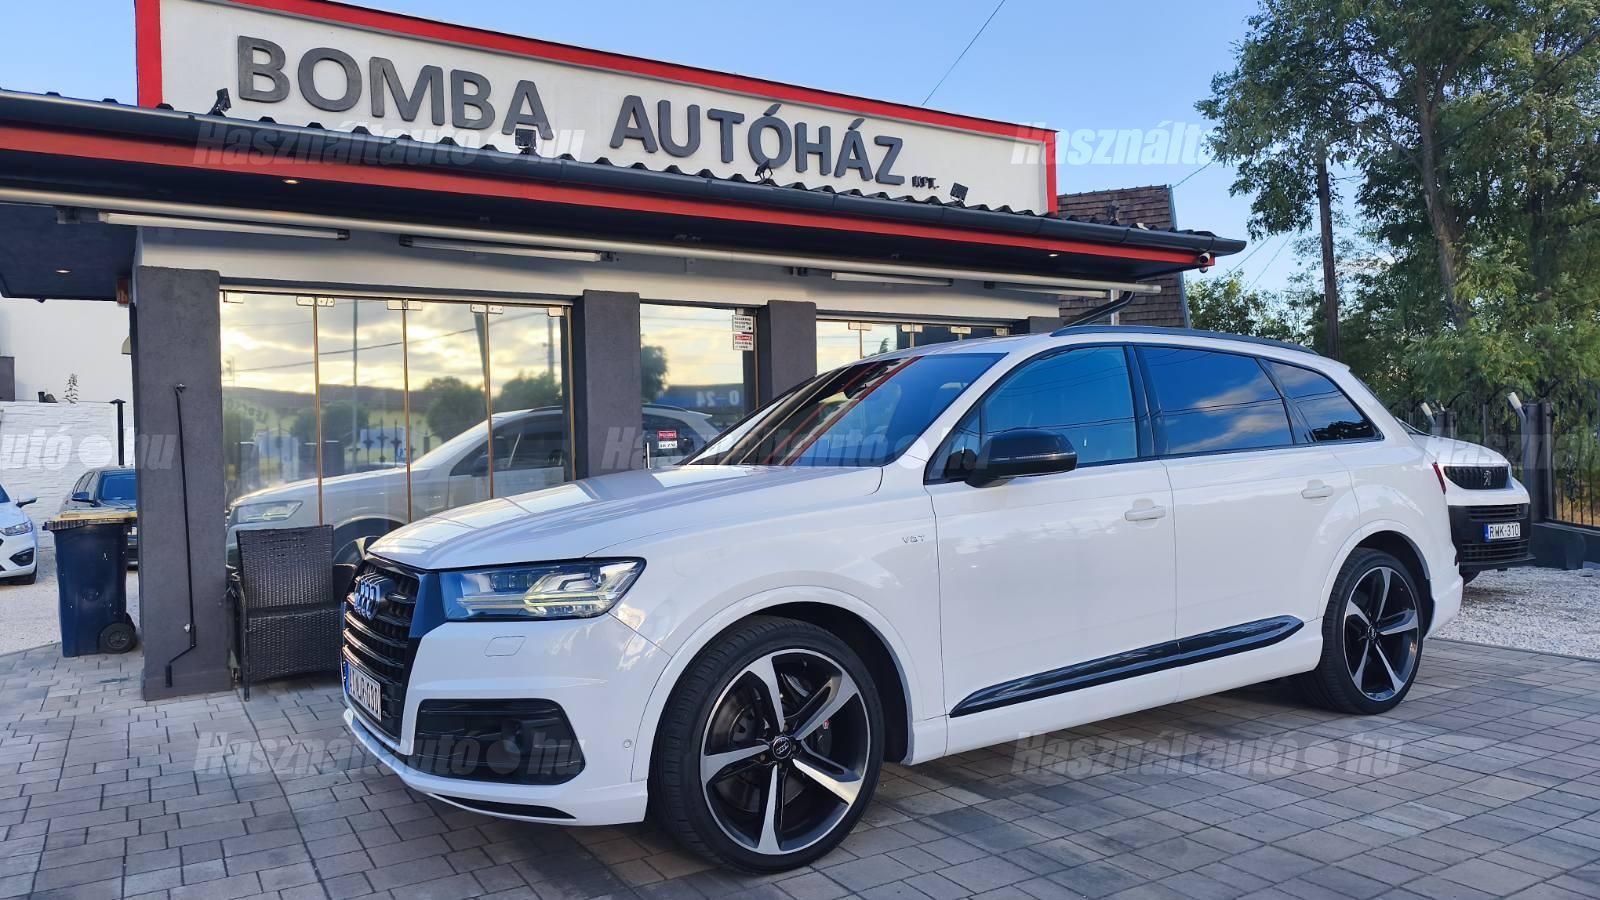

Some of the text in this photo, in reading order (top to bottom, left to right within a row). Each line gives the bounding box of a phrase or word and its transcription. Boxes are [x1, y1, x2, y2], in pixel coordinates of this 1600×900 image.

[237, 34, 554, 141] BOMBA
[608, 94, 906, 186] AUTÓHÁZ
[1489, 523, 1520, 538] RWK-310
